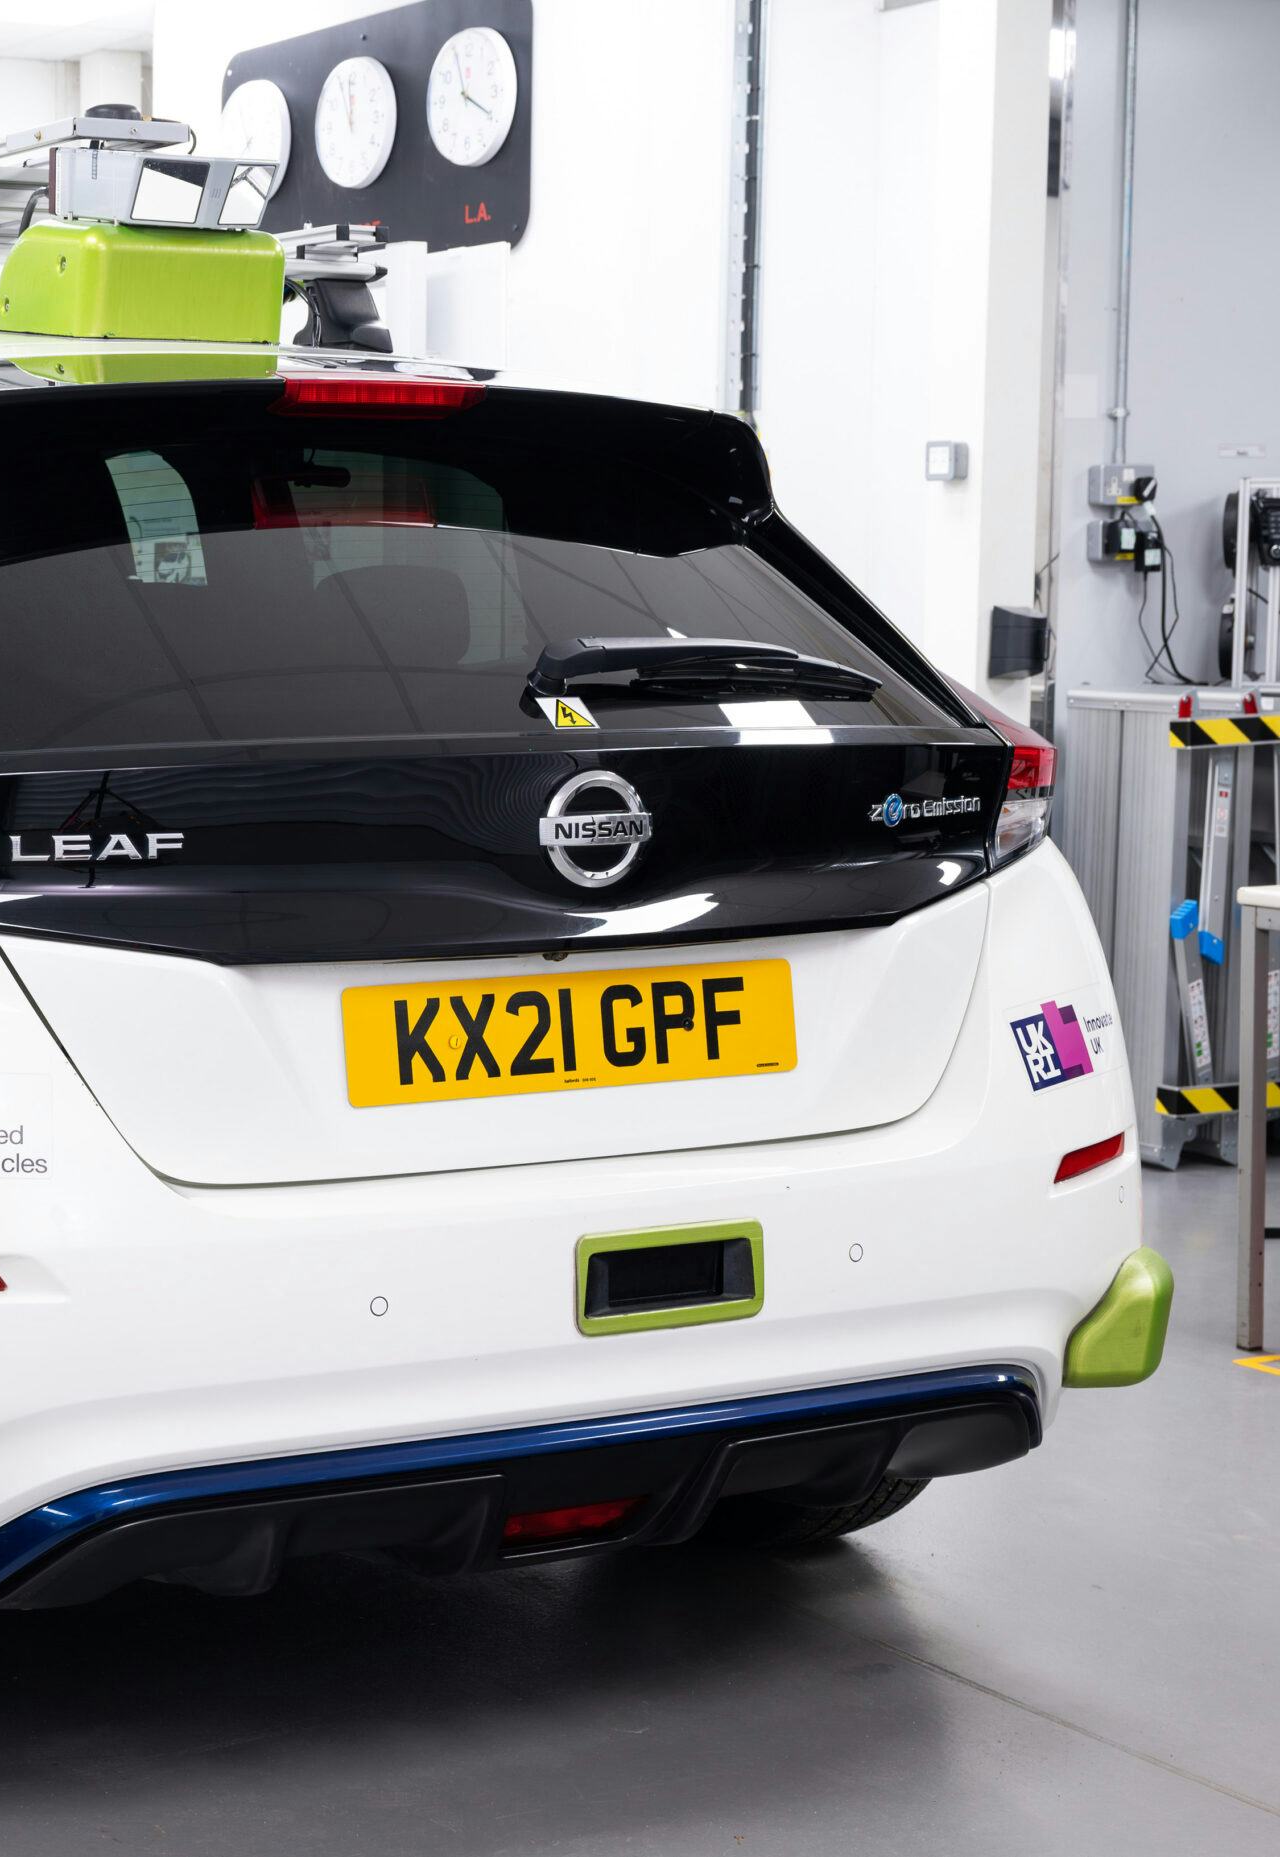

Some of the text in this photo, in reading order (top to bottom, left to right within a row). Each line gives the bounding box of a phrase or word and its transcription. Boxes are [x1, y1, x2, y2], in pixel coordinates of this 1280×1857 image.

[464, 202, 491, 224] L.A.
[923, 795, 980, 817] Emission
[554, 820, 643, 840] NISSAN
[9, 832, 185, 862] LEAF
[393, 976, 745, 1085] KX21 GPF
[1016, 1020, 1055, 1056] UK
[1090, 1036, 1104, 1055] UK
[1026, 1052, 1062, 1084] RI
